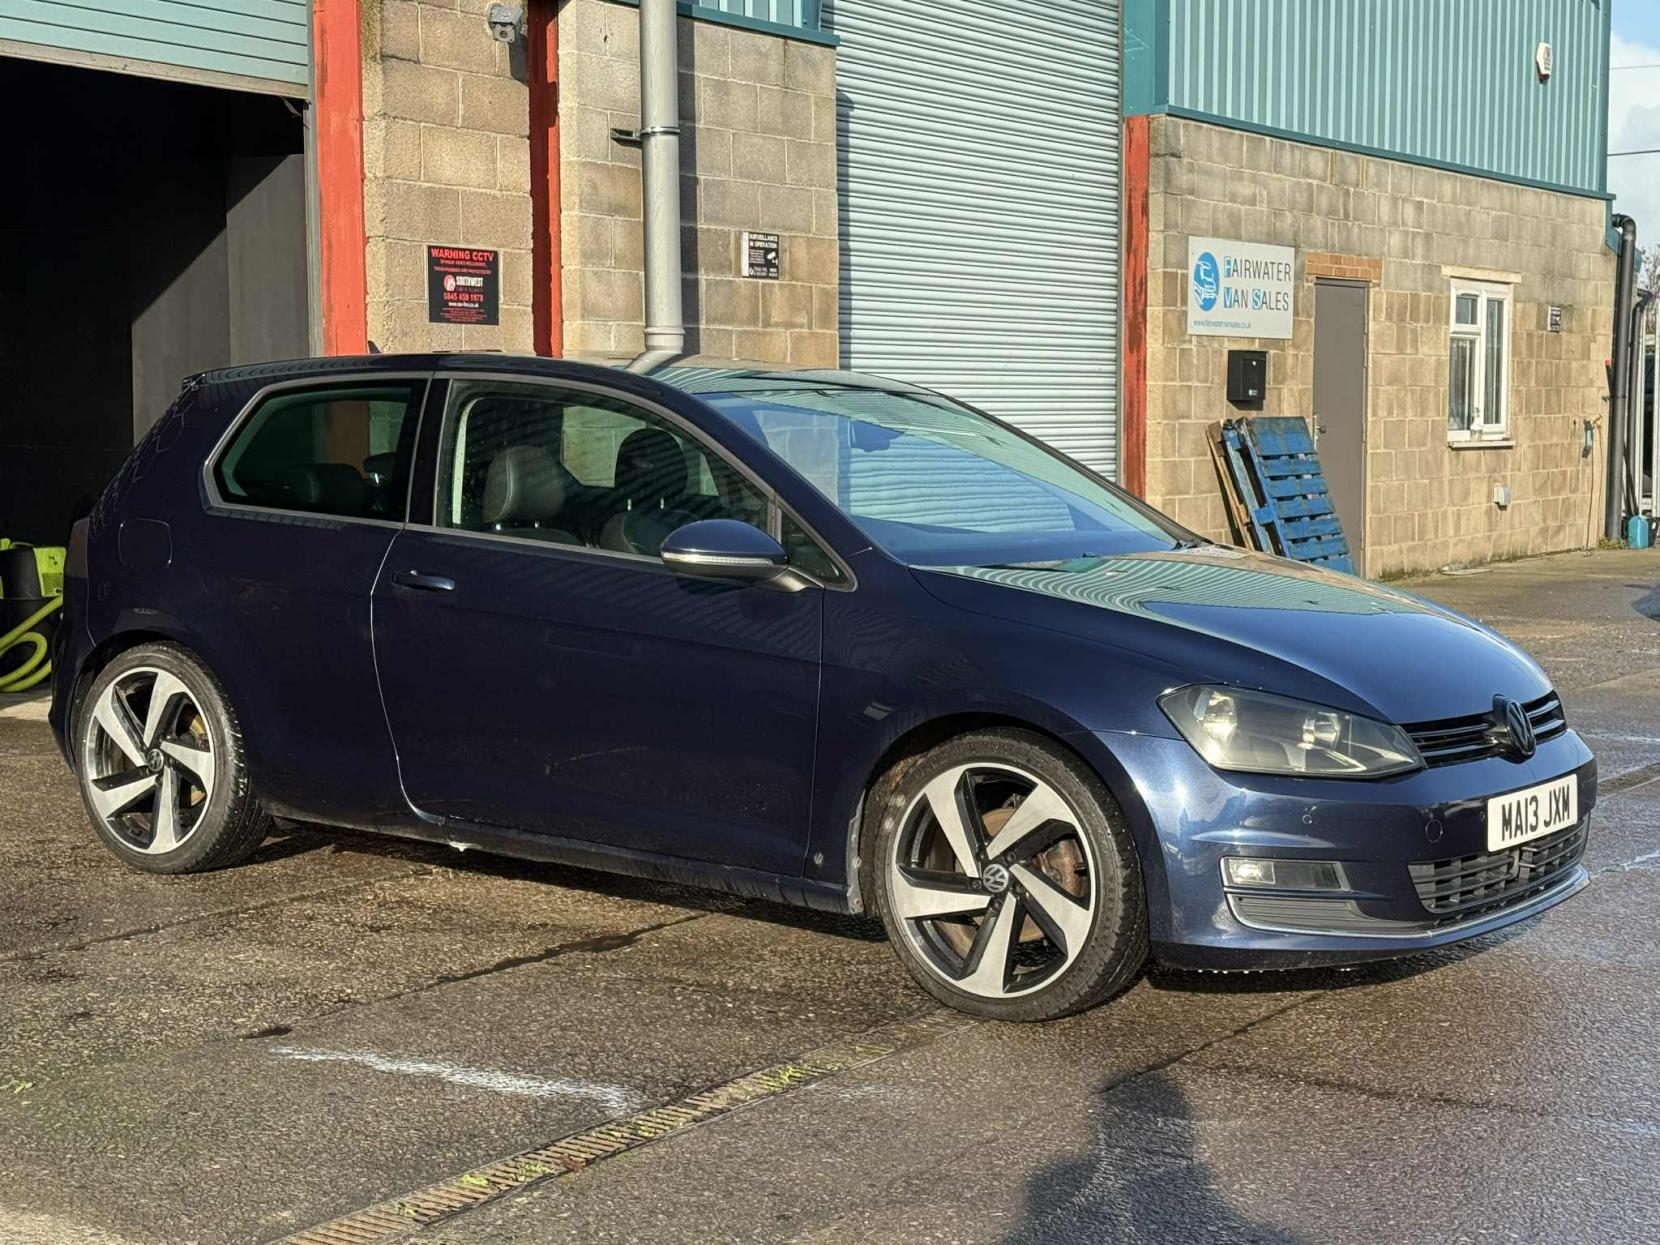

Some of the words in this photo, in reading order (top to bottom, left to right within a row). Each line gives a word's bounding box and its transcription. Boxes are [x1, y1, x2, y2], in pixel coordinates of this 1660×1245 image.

[431, 248, 470, 260] WARNING
[472, 252, 494, 262] CCTV
[1223, 256, 1292, 282] FAIRWATER
[1223, 286, 1249, 309] VAN
[1252, 288, 1290, 312] SALES
[1501, 795, 1539, 842] MA13
[1543, 784, 1570, 828] JXM
